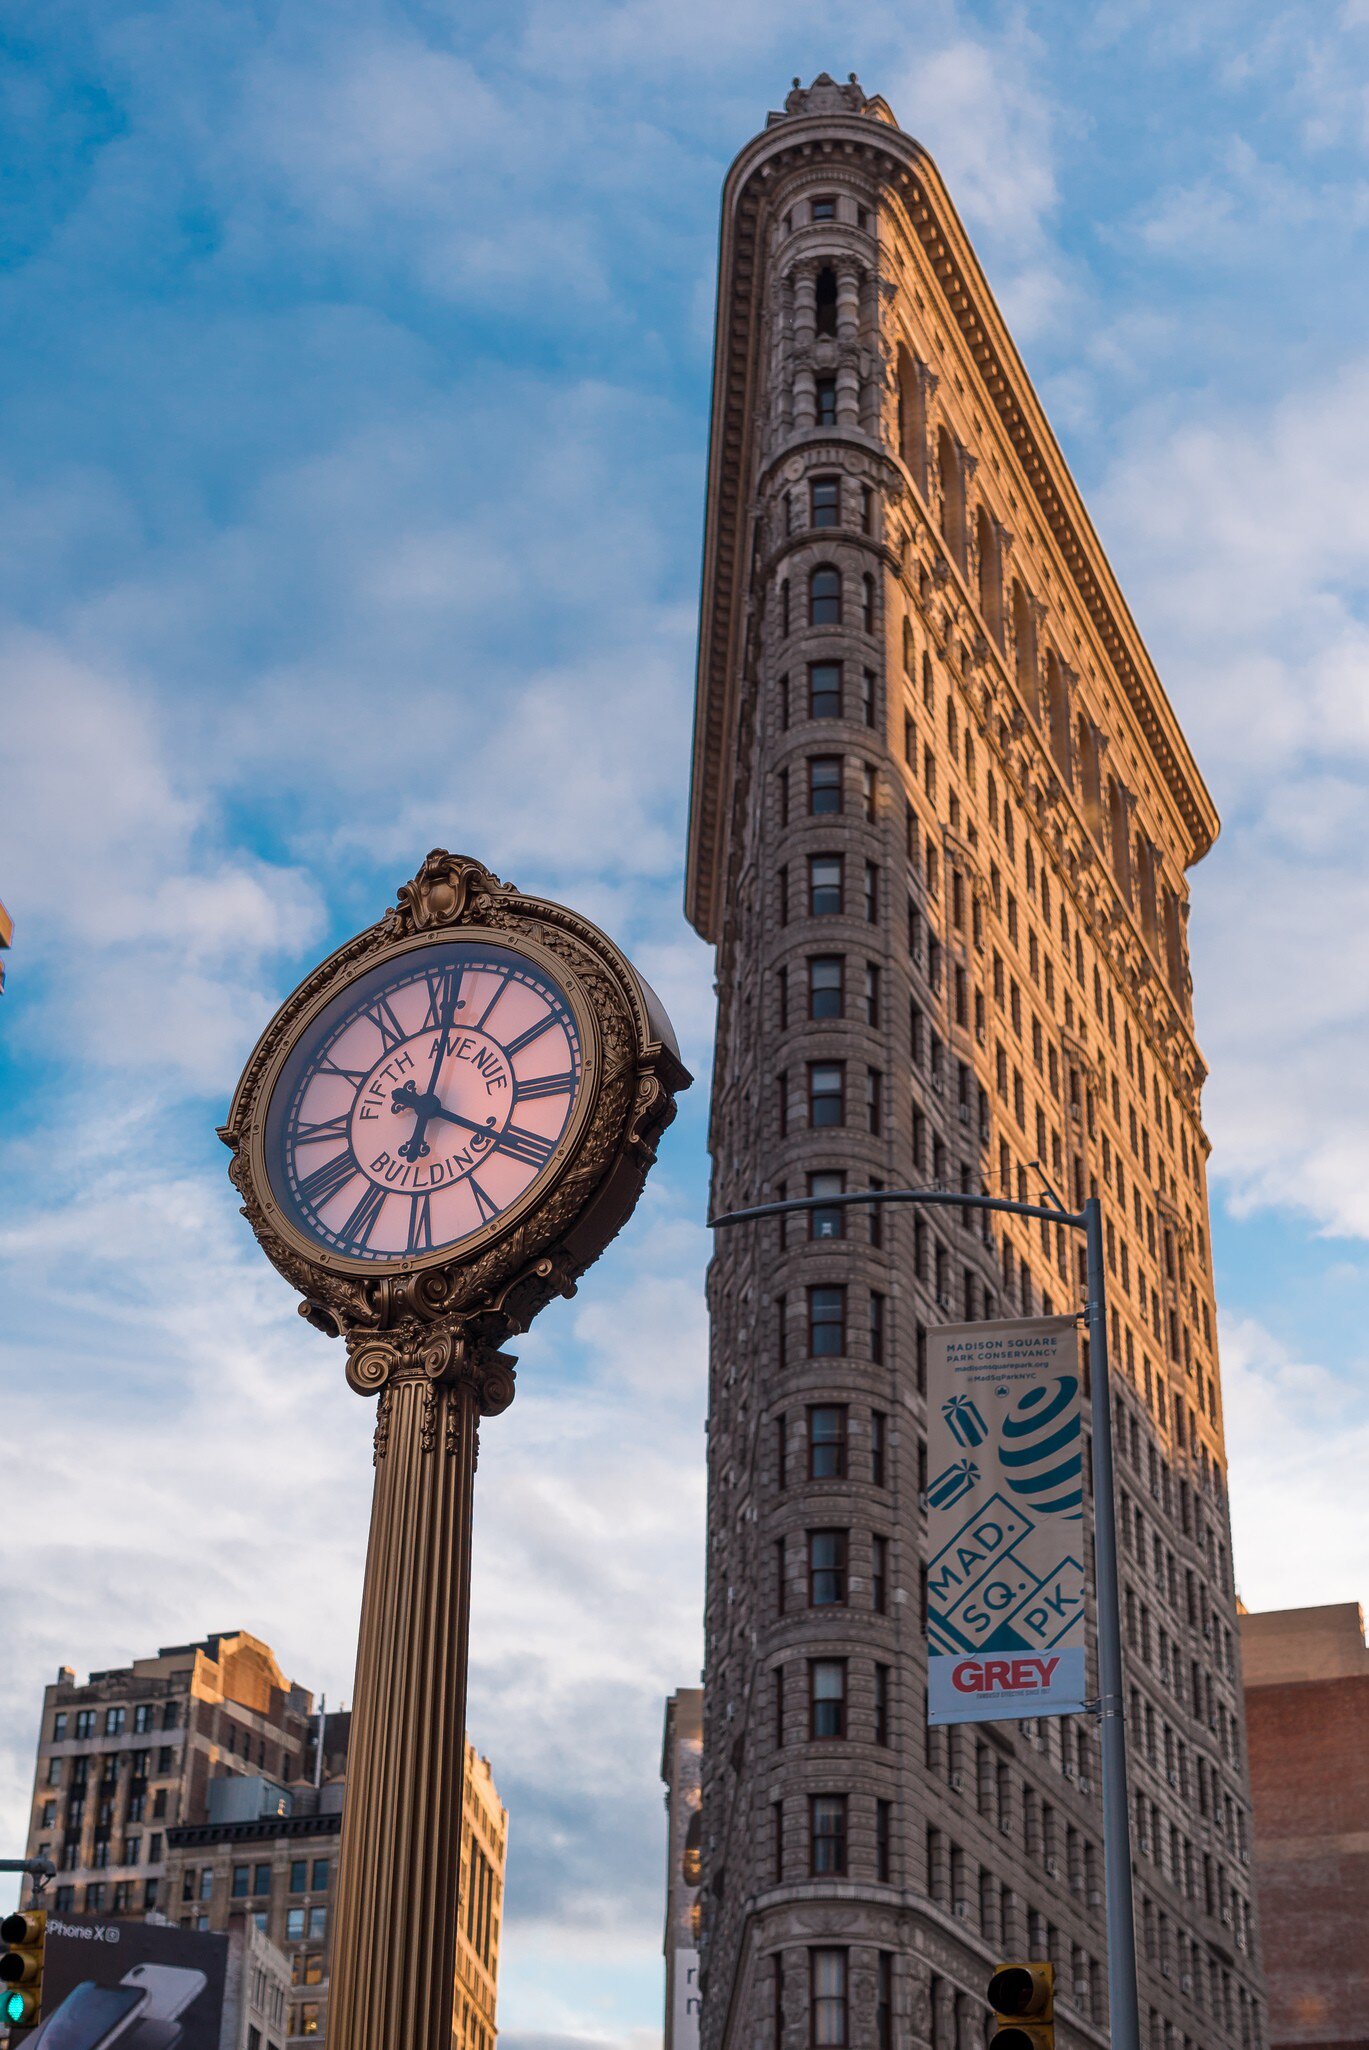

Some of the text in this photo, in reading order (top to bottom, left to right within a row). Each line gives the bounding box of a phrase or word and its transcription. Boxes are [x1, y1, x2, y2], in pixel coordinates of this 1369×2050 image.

[359, 1036, 508, 1121] FIFTH AVENUE
[369, 1134, 492, 1188] BUILDING
[946, 1337, 1057, 1352] MADISON SQUARE
[946, 1349, 1057, 1362] PARK CONSERVANCY
[954, 1361, 1049, 1372] madisonsquarepark.org
[928, 1522, 1015, 1602] MAD.
[962, 1581, 1026, 1633] SQ.
[952, 1657, 1061, 1693] GREY
